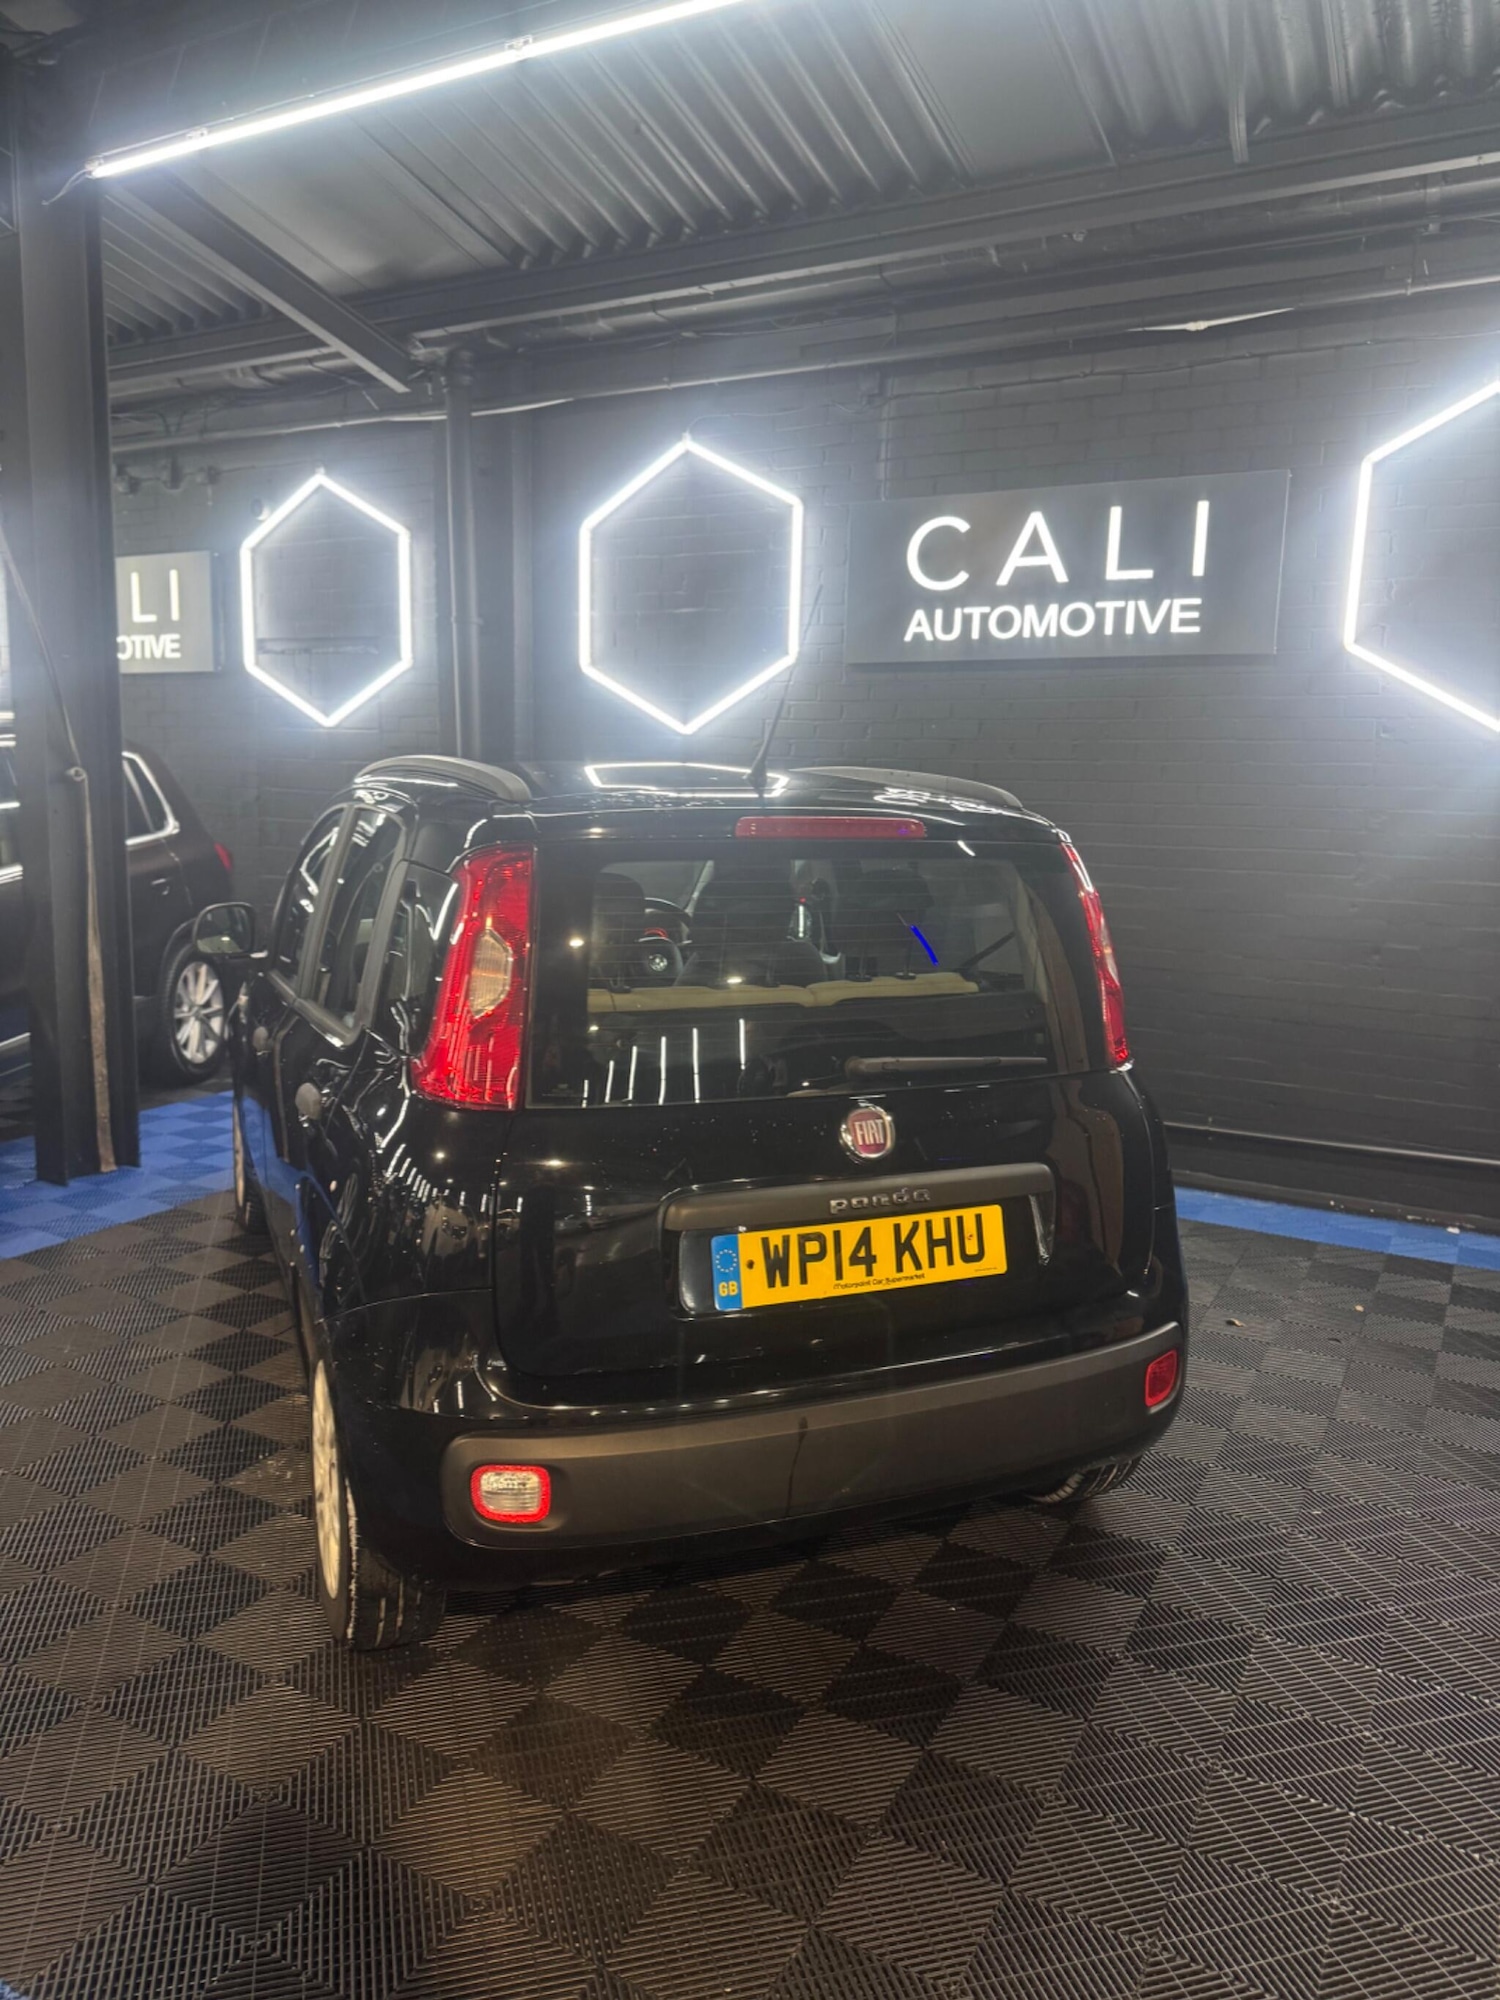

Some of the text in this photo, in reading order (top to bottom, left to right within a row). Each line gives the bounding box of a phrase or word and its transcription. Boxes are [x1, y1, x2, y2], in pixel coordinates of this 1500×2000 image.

[906, 500, 1210, 591] CALI
[904, 598, 1202, 642] AUTOMOTIVE
[854, 1119, 885, 1146] FIAT
[761, 1213, 985, 1288] WP14 KHU
[718, 1280, 738, 1297] GB
